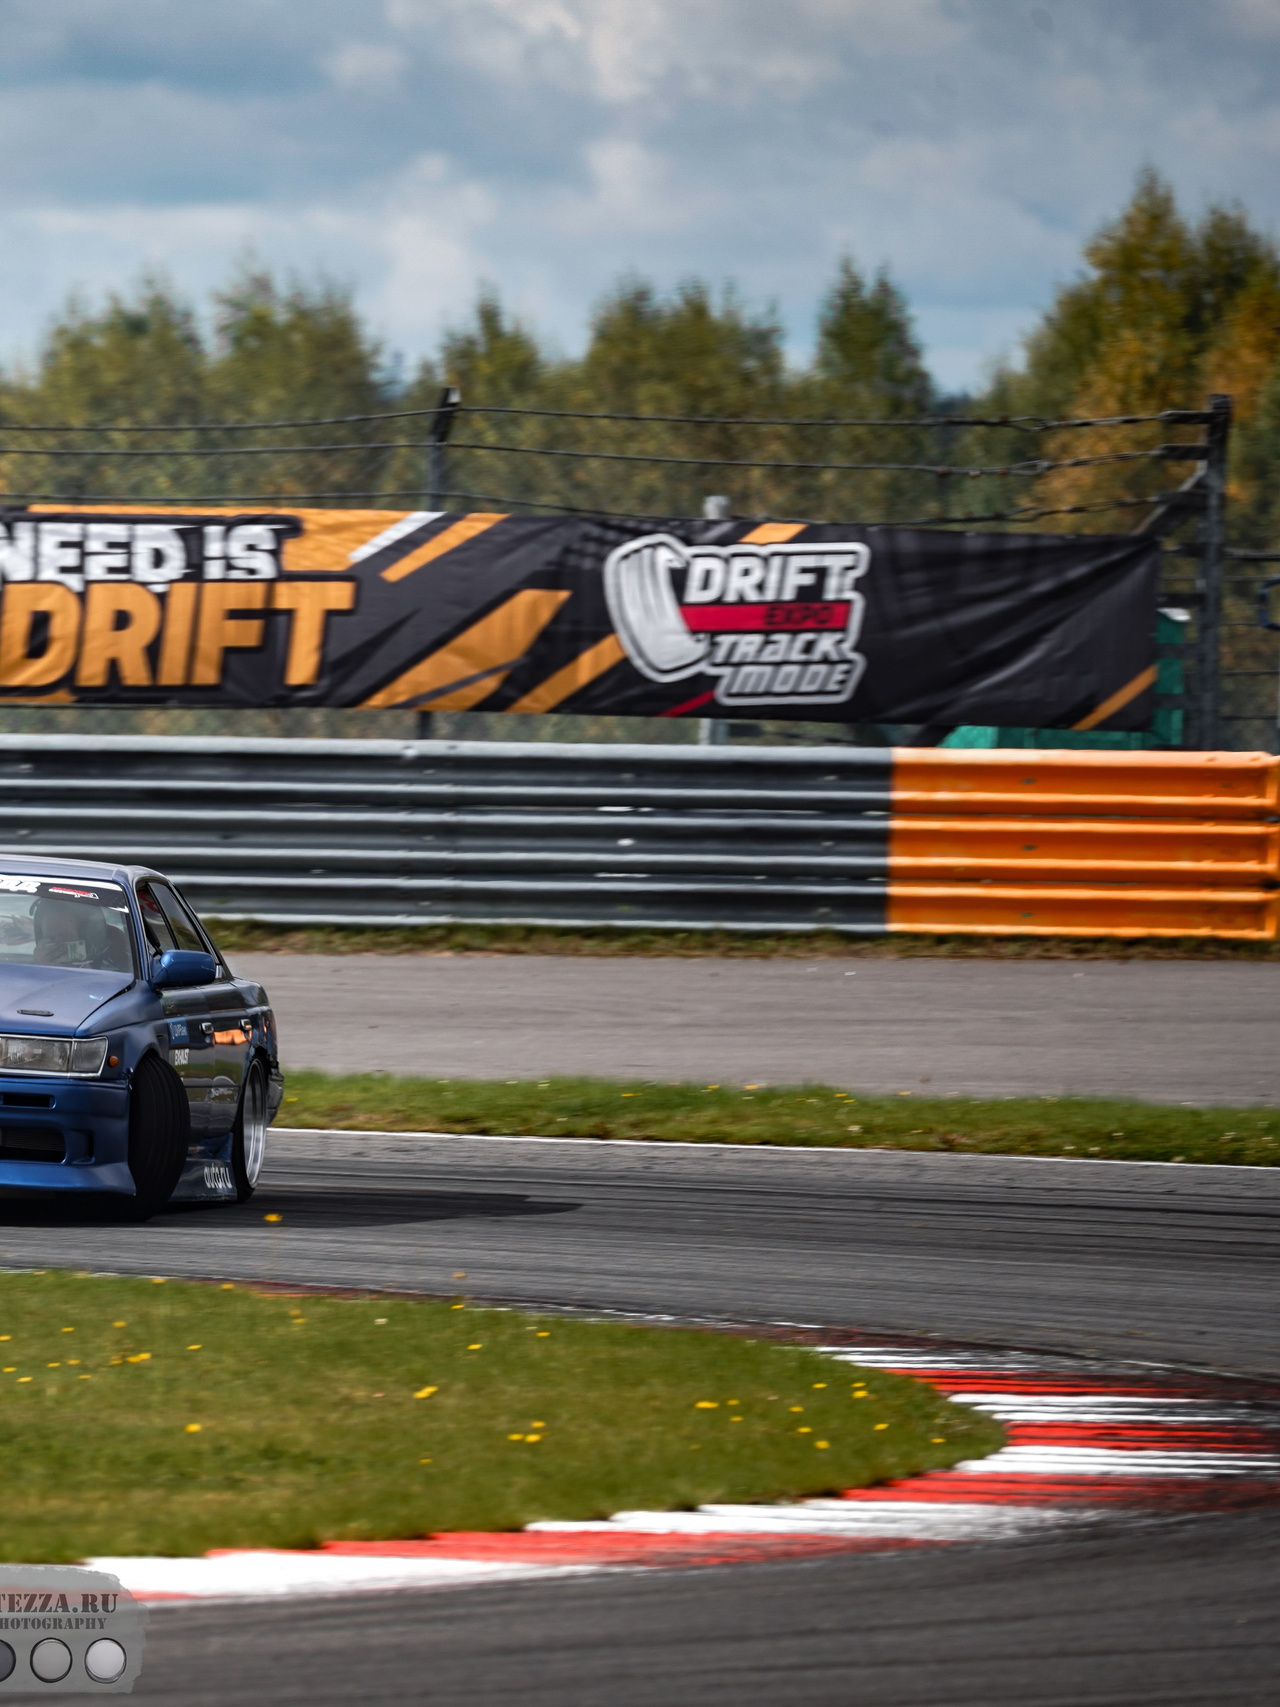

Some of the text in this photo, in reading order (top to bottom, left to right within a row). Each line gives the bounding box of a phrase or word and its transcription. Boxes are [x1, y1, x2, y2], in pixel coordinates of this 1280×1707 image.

[203, 525, 290, 580] IS
[683, 554, 856, 602] DRIFT
[765, 604, 833, 625] EXPO
[730, 665, 851, 692] MODE
